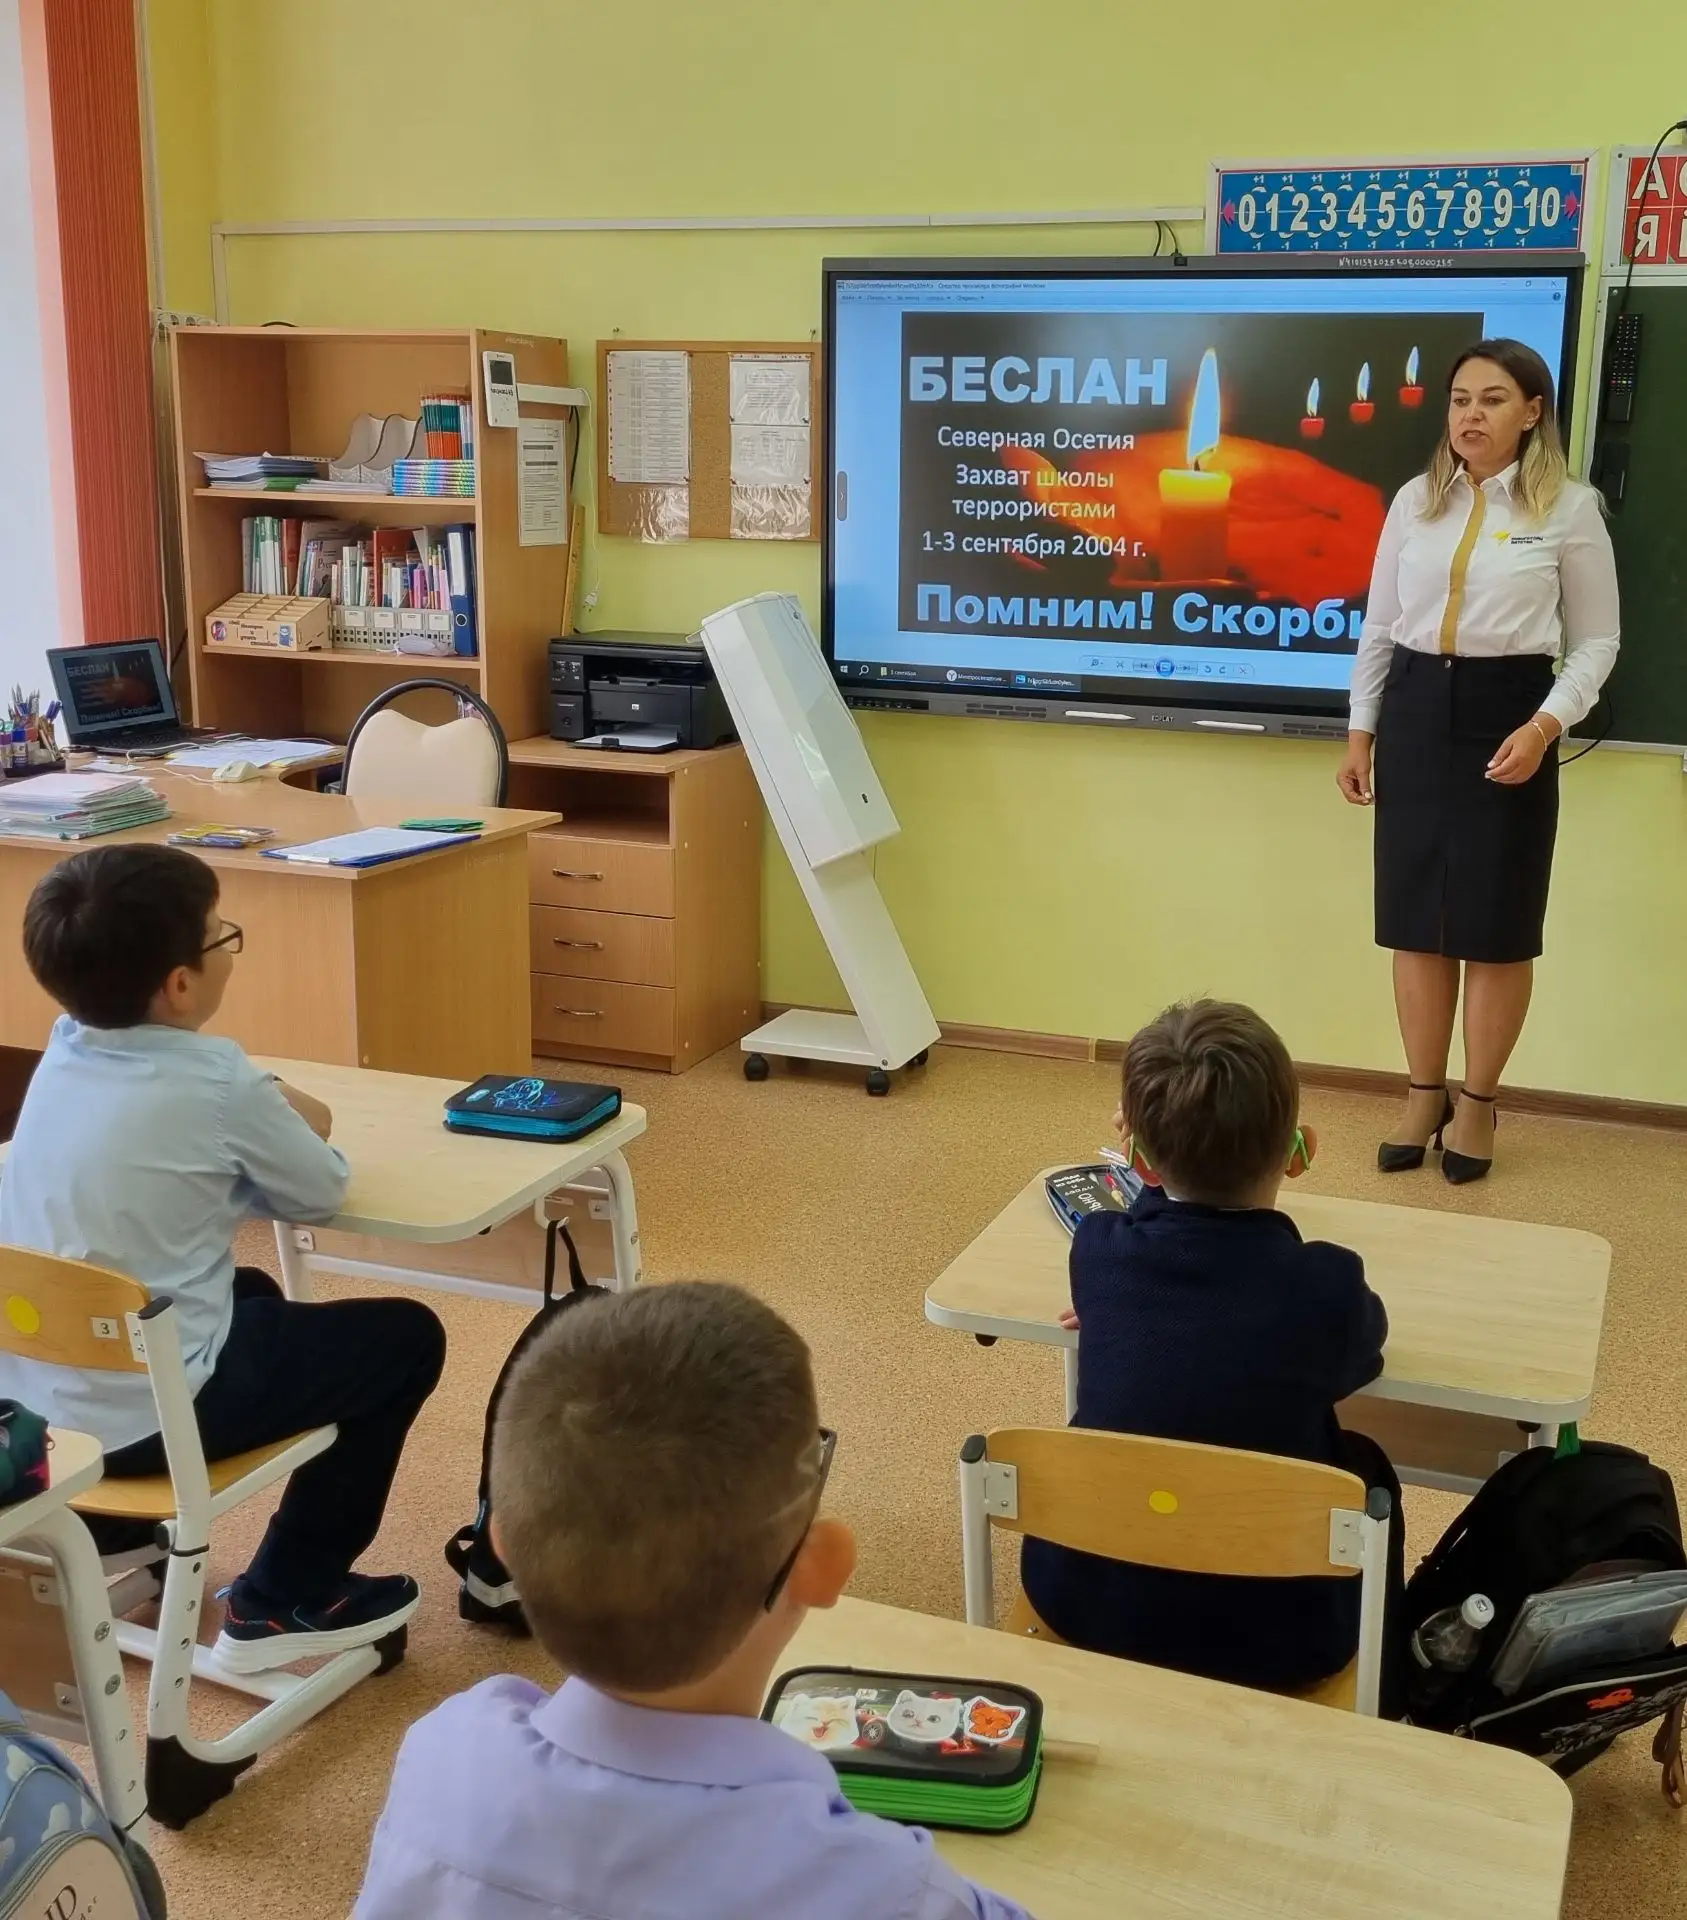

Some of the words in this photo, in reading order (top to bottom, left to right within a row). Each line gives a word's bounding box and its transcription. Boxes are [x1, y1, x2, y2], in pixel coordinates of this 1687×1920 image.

[1253, 174, 1264, 183] +1
[1282, 174, 1293, 183] +1
[1311, 174, 1322, 182] +1
[1340, 173, 1352, 181] +1
[1369, 172, 1380, 181] +1
[1398, 171, 1409, 180] +1
[1428, 170, 1440, 179] +1
[1456, 169, 1468, 178] +1
[1487, 169, 1499, 177] +1
[1519, 168, 1530, 177] +1
[1238, 193, 1256, 233] 0
[1265, 192, 1279, 232] 1
[1290, 192, 1310, 231] 2
[1319, 192, 1338, 231] 3
[1346, 191, 1367, 230] 4
[1376, 191, 1396, 230] 5
[1406, 190, 1426, 230] 6
[1435, 190, 1455, 229] 7
[1463, 188, 1483, 229] 8
[1493, 188, 1513, 228] 9
[1523, 186, 1561, 227] 10
[909, 355, 1168, 406] БЕСЛАН
[938, 426, 1045, 452] Северная
[1053, 429, 1135, 450] Осетия
[956, 464, 1030, 486] Захват
[1036, 469, 1114, 488] школы
[952, 498, 1116, 521] террористами
[922, 531, 955, 552] 1-3
[962, 532, 1065, 560] сентября
[1071, 535, 1127, 557] 2004
[1133, 541, 1147, 557] г.
[916, 583, 1153, 631] Помним!
[100, 1322, 111, 1335] 3
